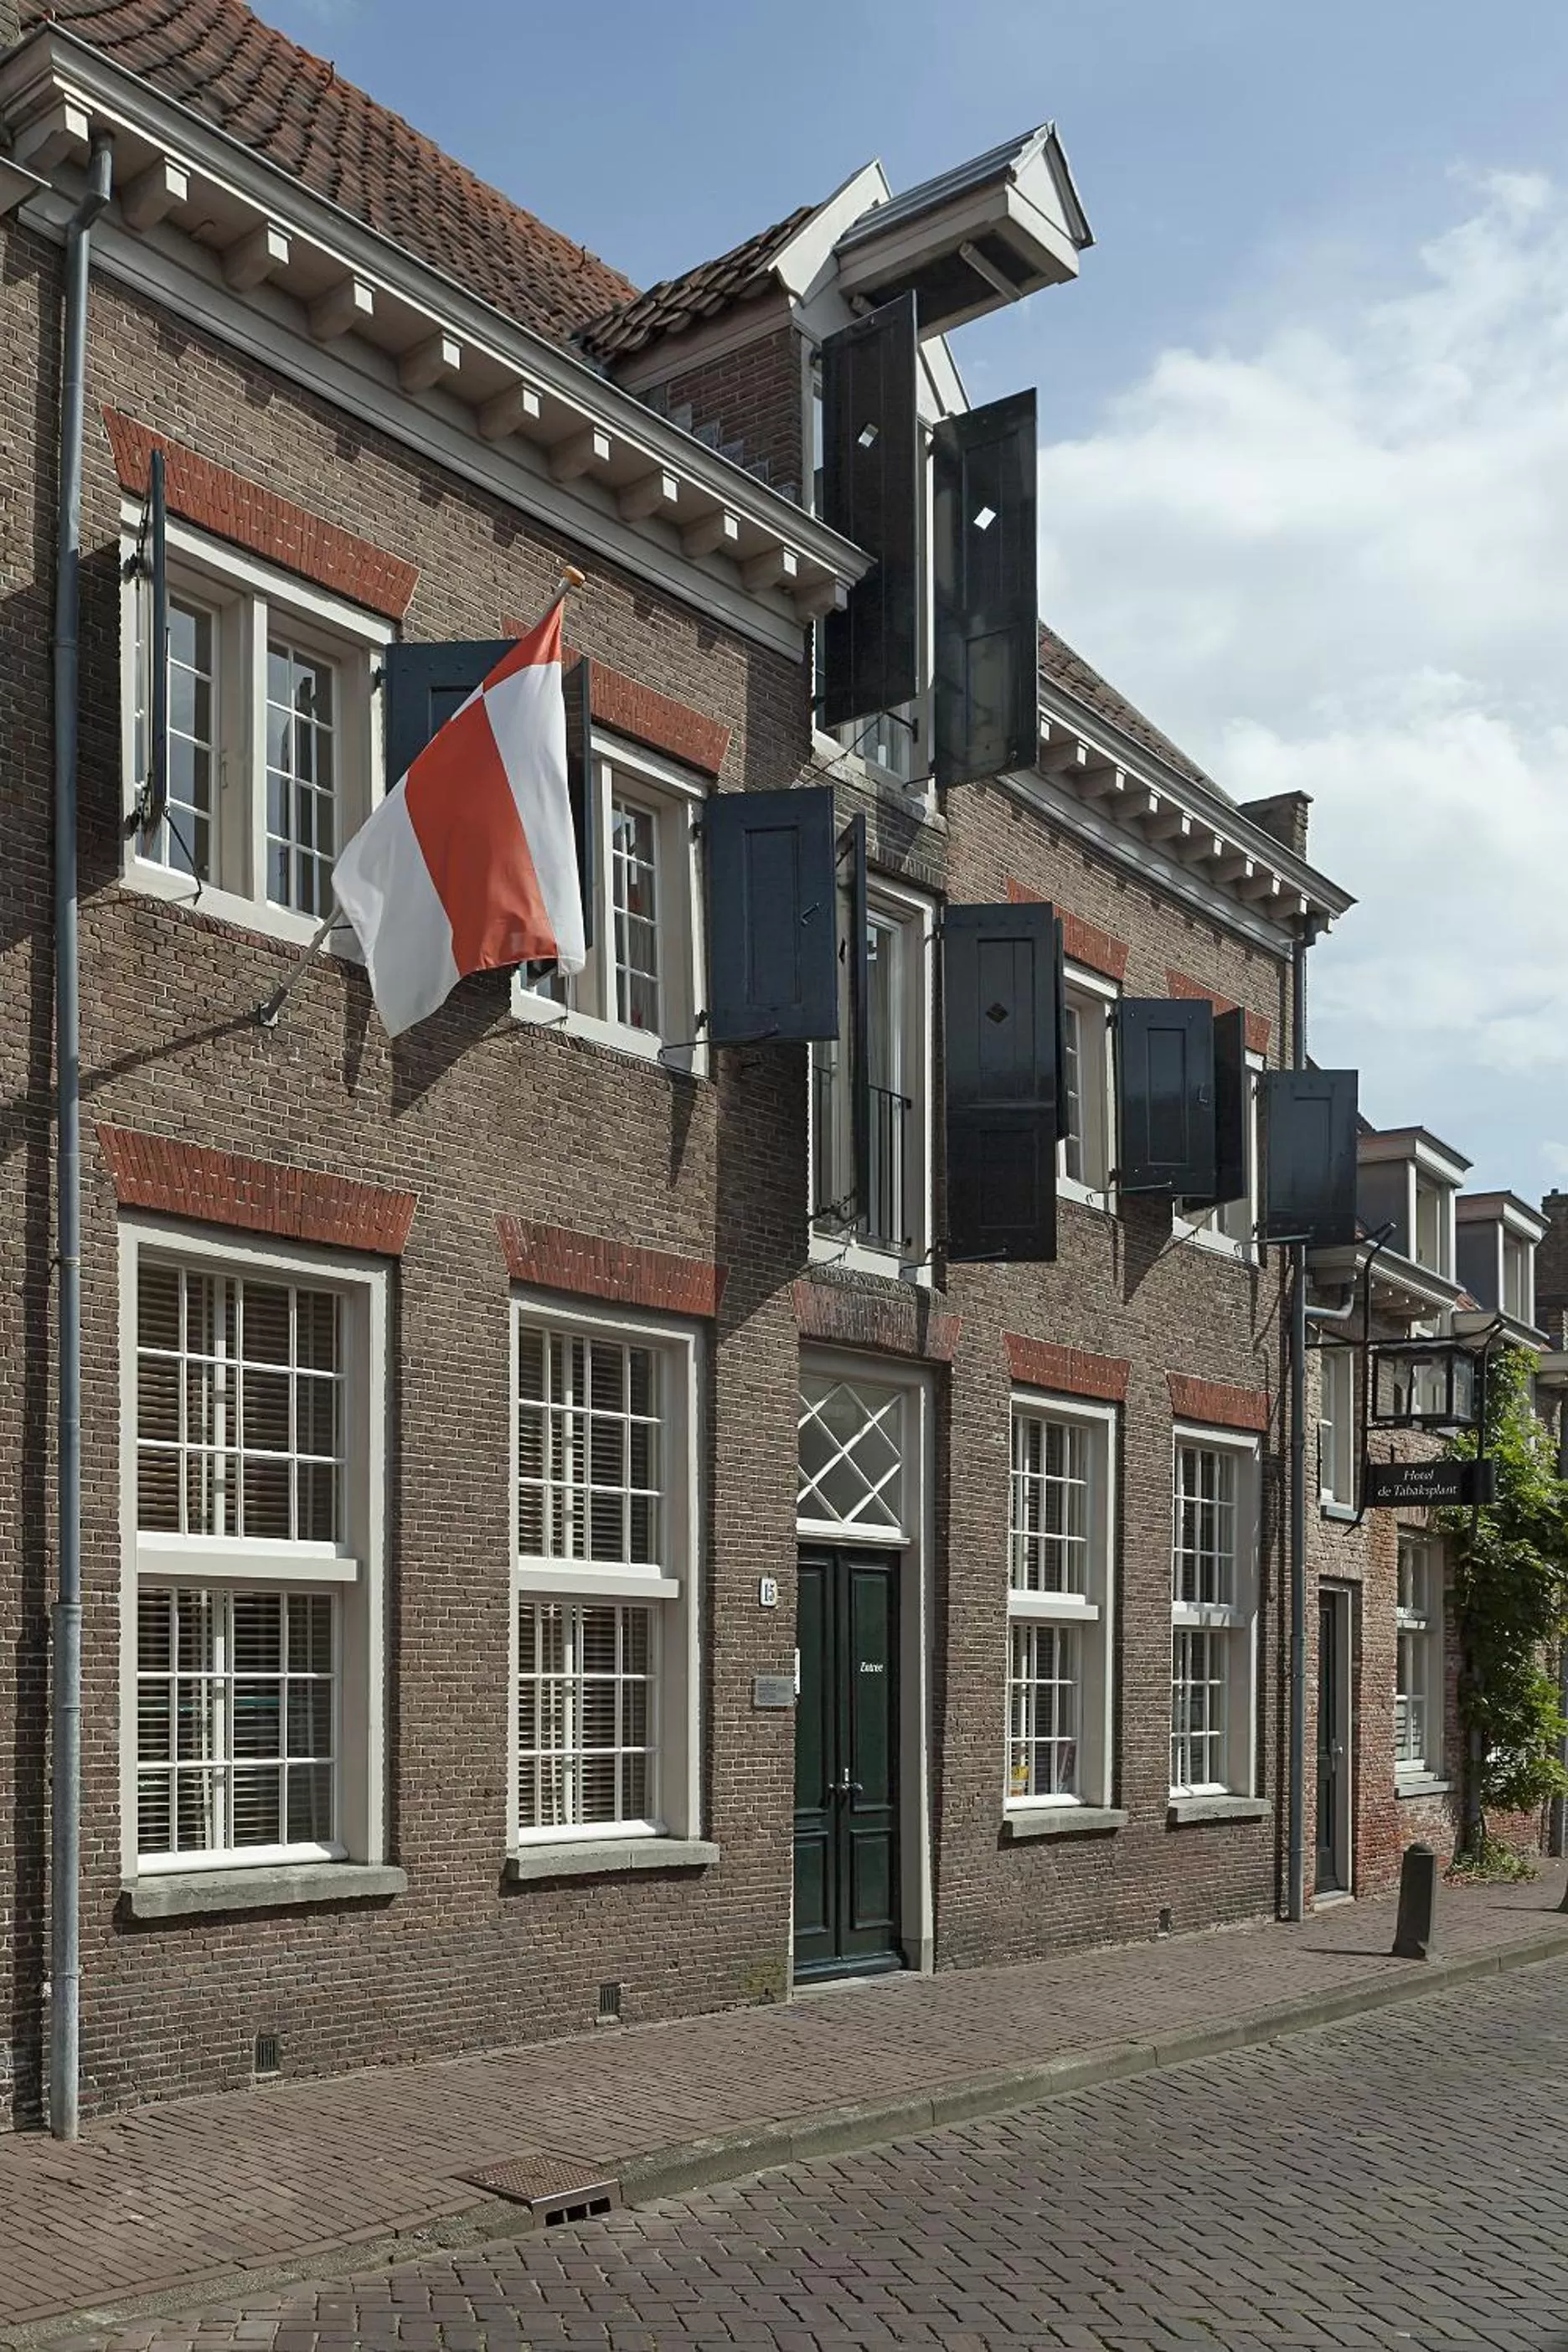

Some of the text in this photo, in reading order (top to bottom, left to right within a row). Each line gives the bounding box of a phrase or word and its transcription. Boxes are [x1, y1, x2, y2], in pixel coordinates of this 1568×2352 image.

[1403, 1469, 1434, 1481] Hotel
[1377, 1484, 1458, 1498] de Tabaksplant
